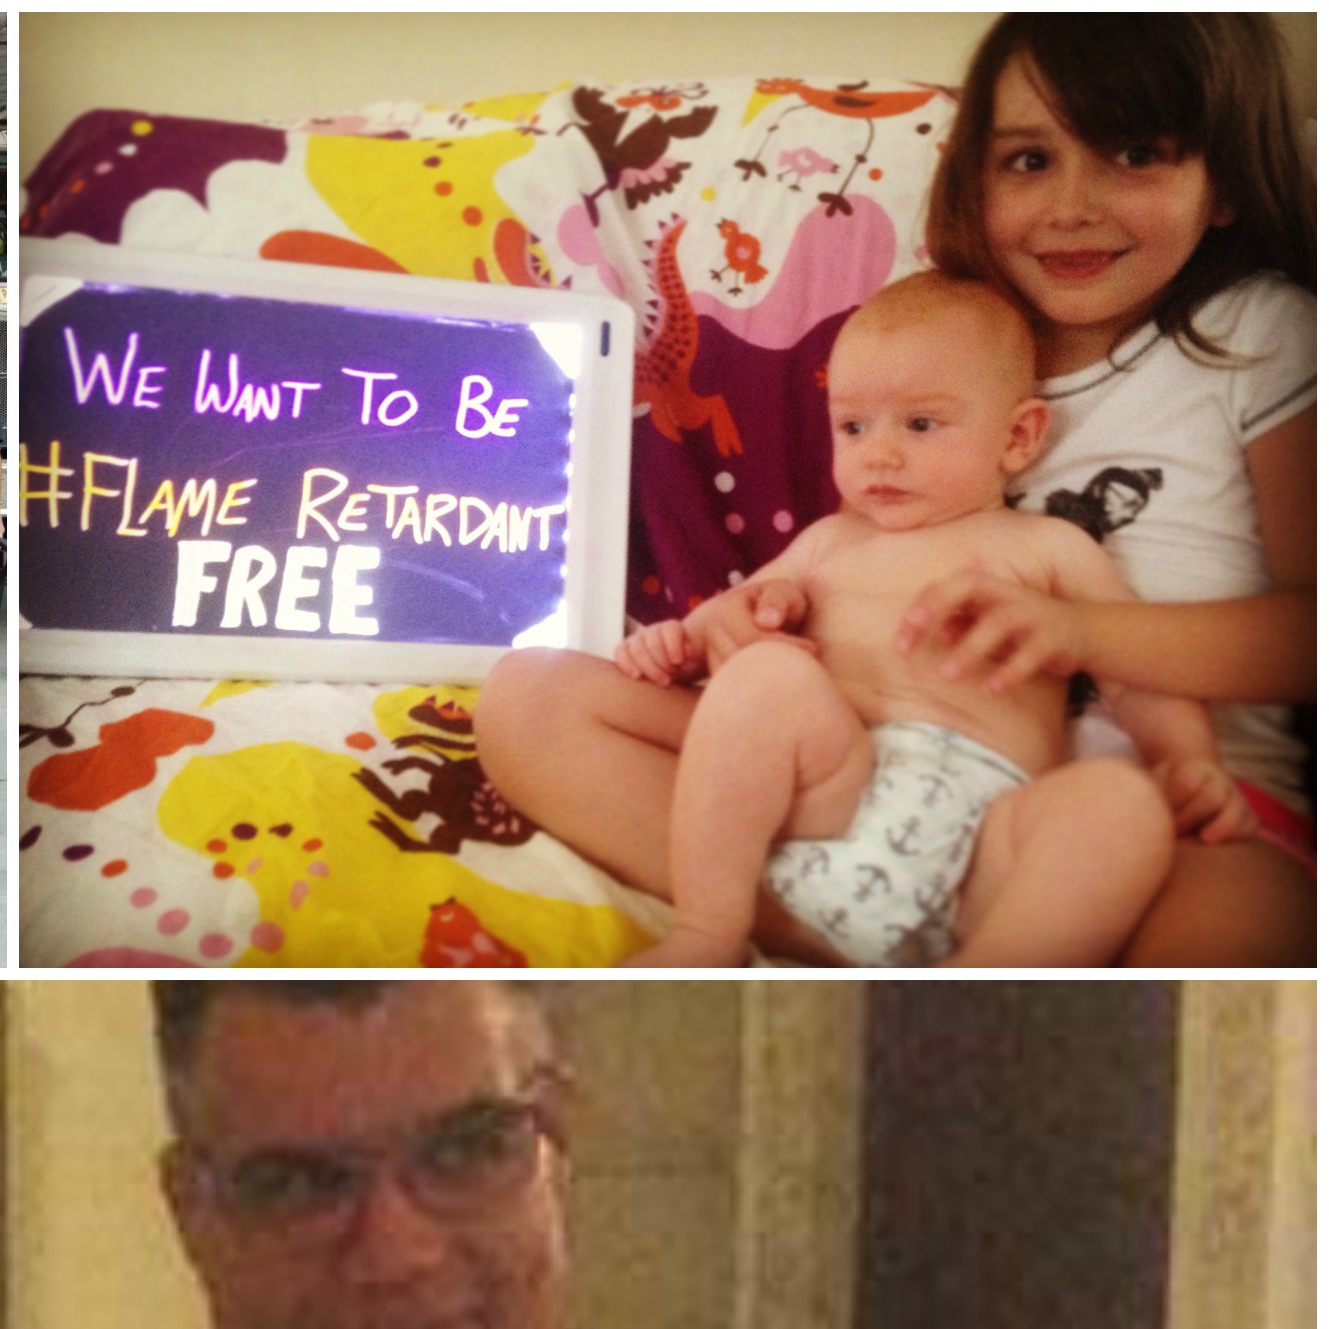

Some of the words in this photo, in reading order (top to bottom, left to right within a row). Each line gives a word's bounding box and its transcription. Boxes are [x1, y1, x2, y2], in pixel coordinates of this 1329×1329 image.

[64, 328, 167, 409] WE
[194, 350, 322, 423] WANT
[341, 368, 418, 427] TO
[456, 375, 529, 438] BE
[296, 468, 568, 553] RETARDANT
[172, 541, 381, 636] FREE
